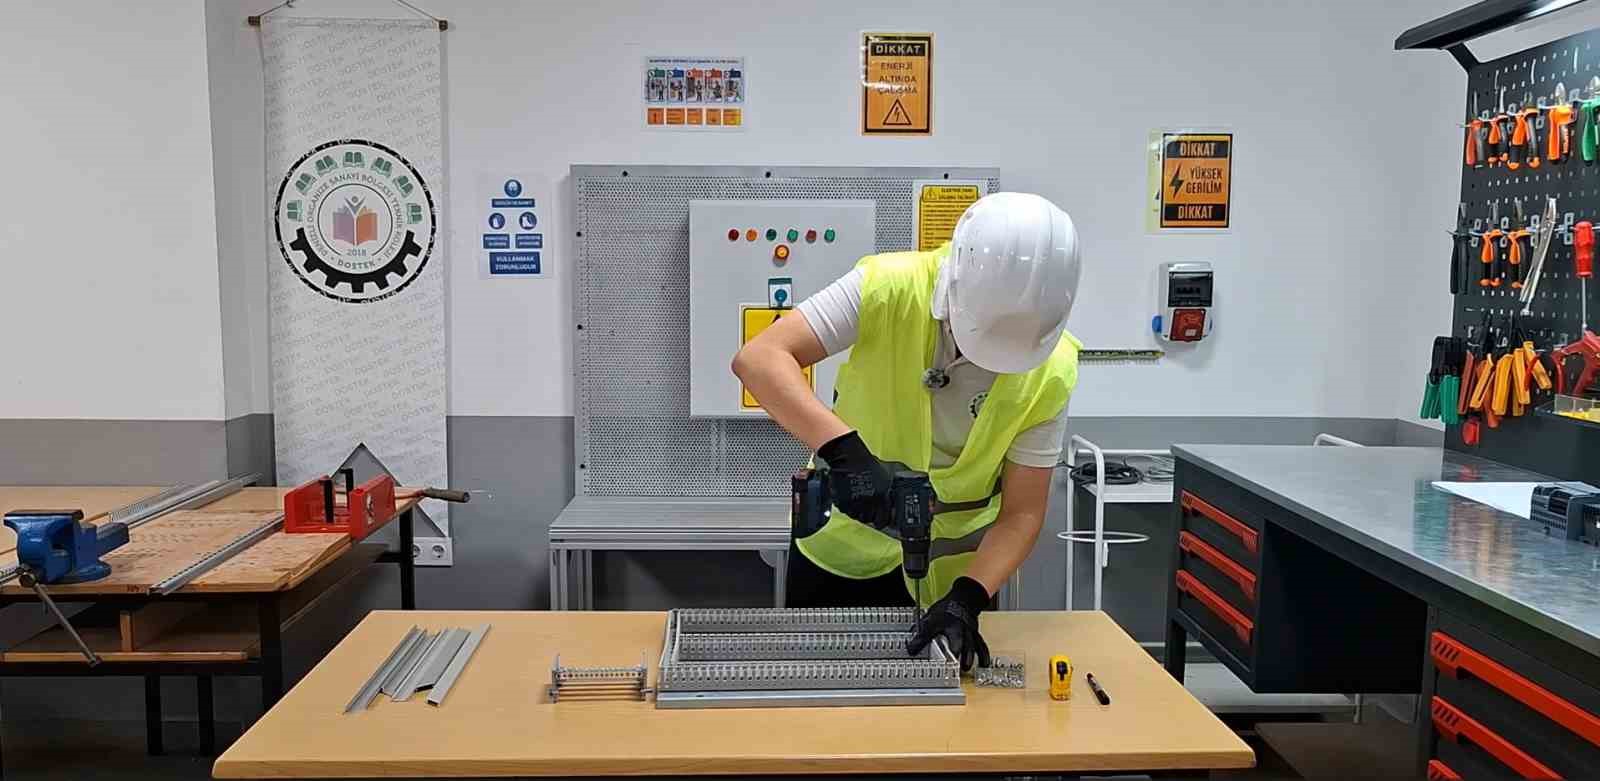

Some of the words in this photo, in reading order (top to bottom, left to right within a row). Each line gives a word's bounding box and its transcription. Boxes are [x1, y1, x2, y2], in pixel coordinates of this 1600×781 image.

[875, 43, 920, 54] DİKKAT
[880, 62, 912, 70] ENERJİ
[1180, 141, 1216, 156] DİKKAT
[1190, 166, 1223, 179] YÜKSEK
[1186, 181, 1222, 194] GERİLİM
[1178, 204, 1213, 219] DİKKAT
[345, 249, 367, 258] 2018
[337, 259, 376, 270] DOSTEK
